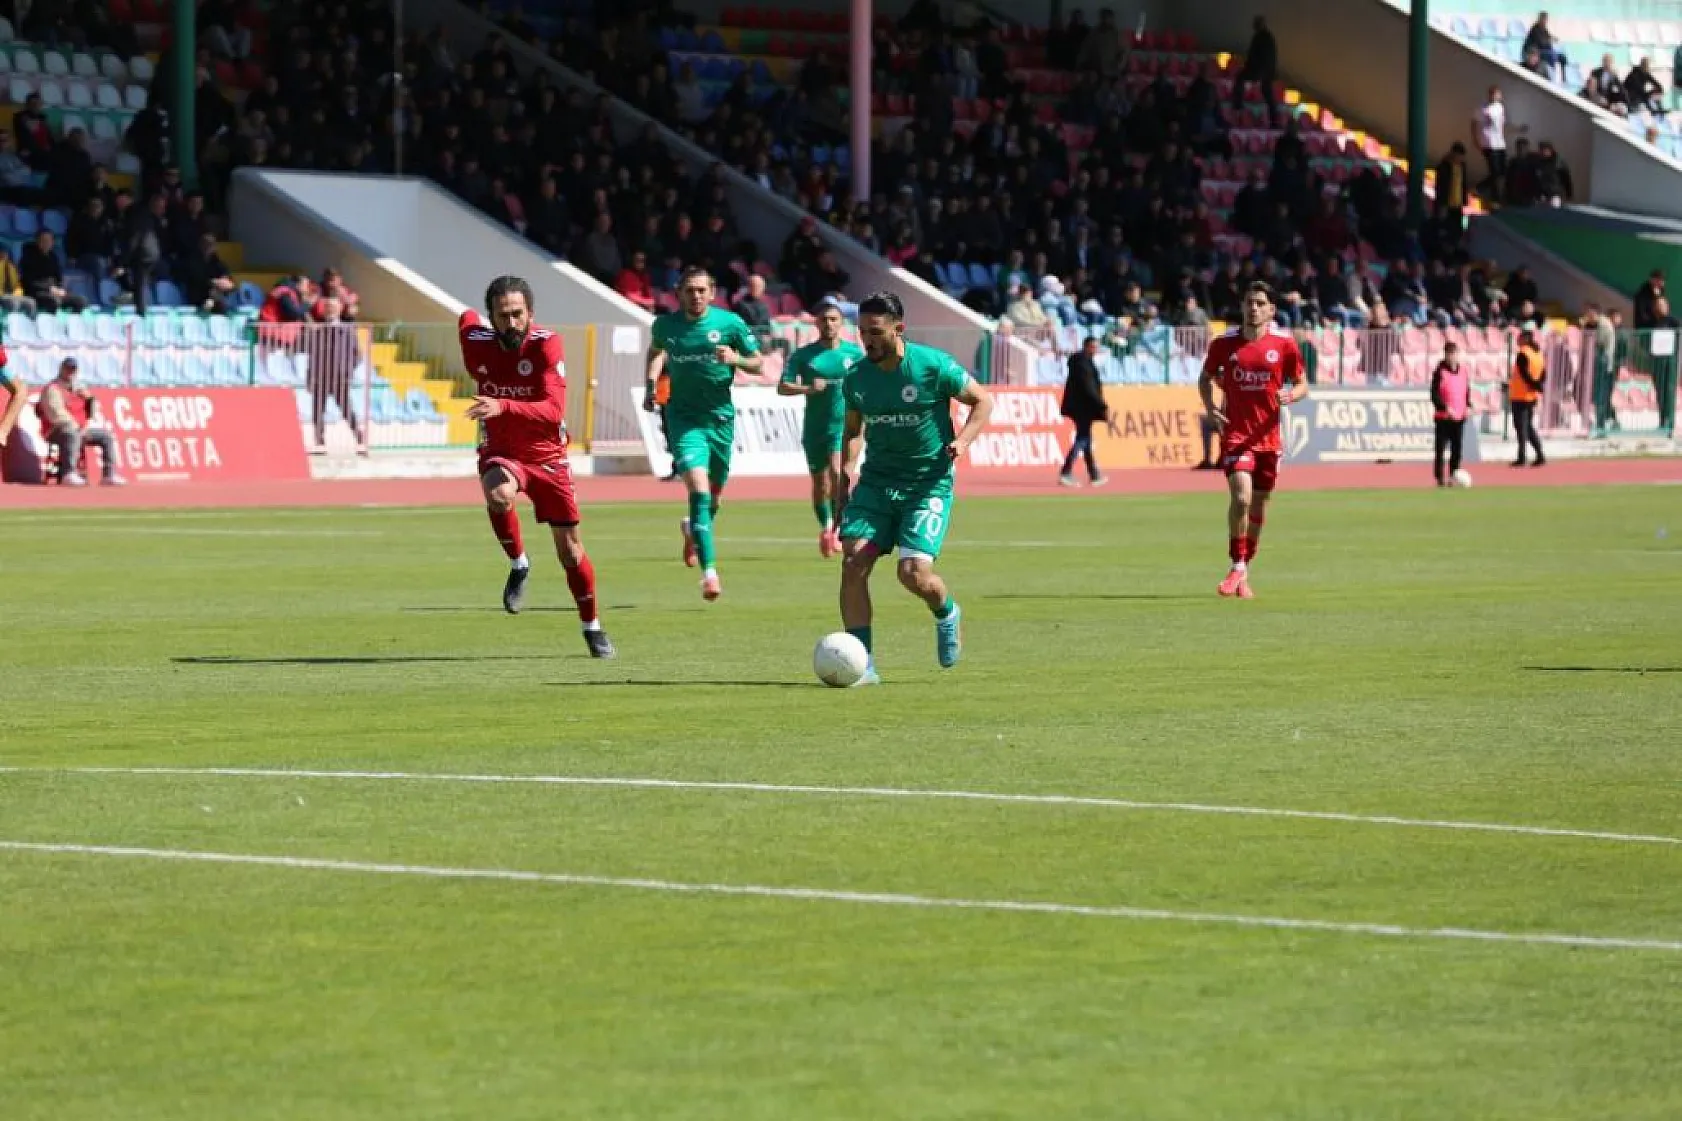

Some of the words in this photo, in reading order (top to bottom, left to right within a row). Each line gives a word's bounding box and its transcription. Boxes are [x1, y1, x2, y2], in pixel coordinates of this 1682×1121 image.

[144, 396, 213, 430] GRUP
[989, 391, 1064, 425] MEDYA
[1315, 400, 1368, 428] AGD
[1106, 408, 1190, 438] KAHVE
[1146, 443, 1193, 464] KAFE
[909, 509, 943, 537] 70
